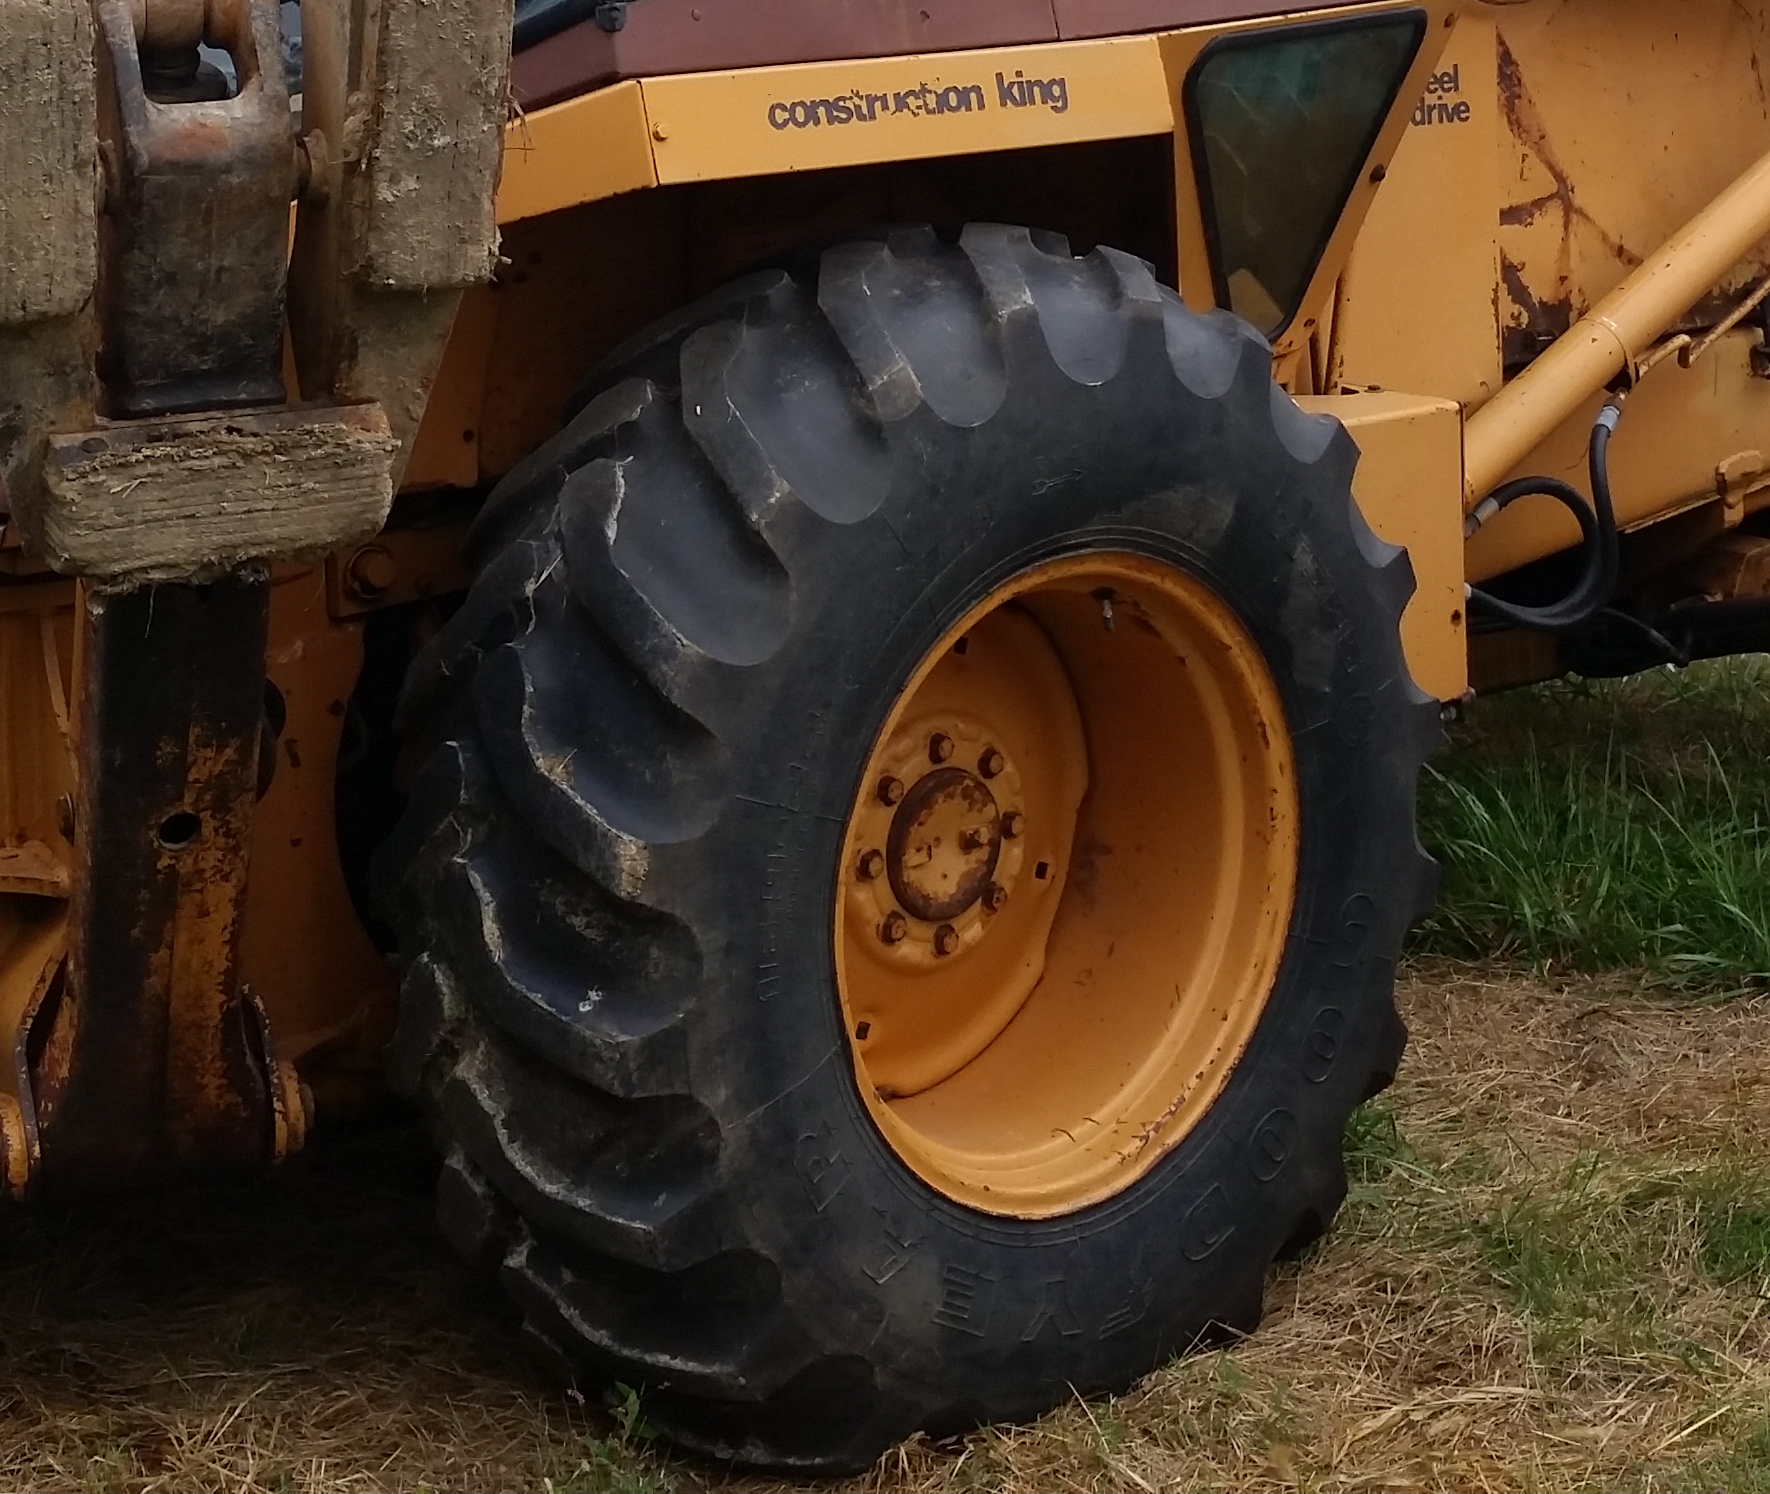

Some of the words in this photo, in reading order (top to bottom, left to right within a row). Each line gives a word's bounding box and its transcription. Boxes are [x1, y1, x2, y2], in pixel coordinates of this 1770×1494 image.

[1425, 63, 1460, 94] eel
[767, 79, 985, 131] construction
[995, 70, 1068, 114] king
[1411, 94, 1470, 126] drive
